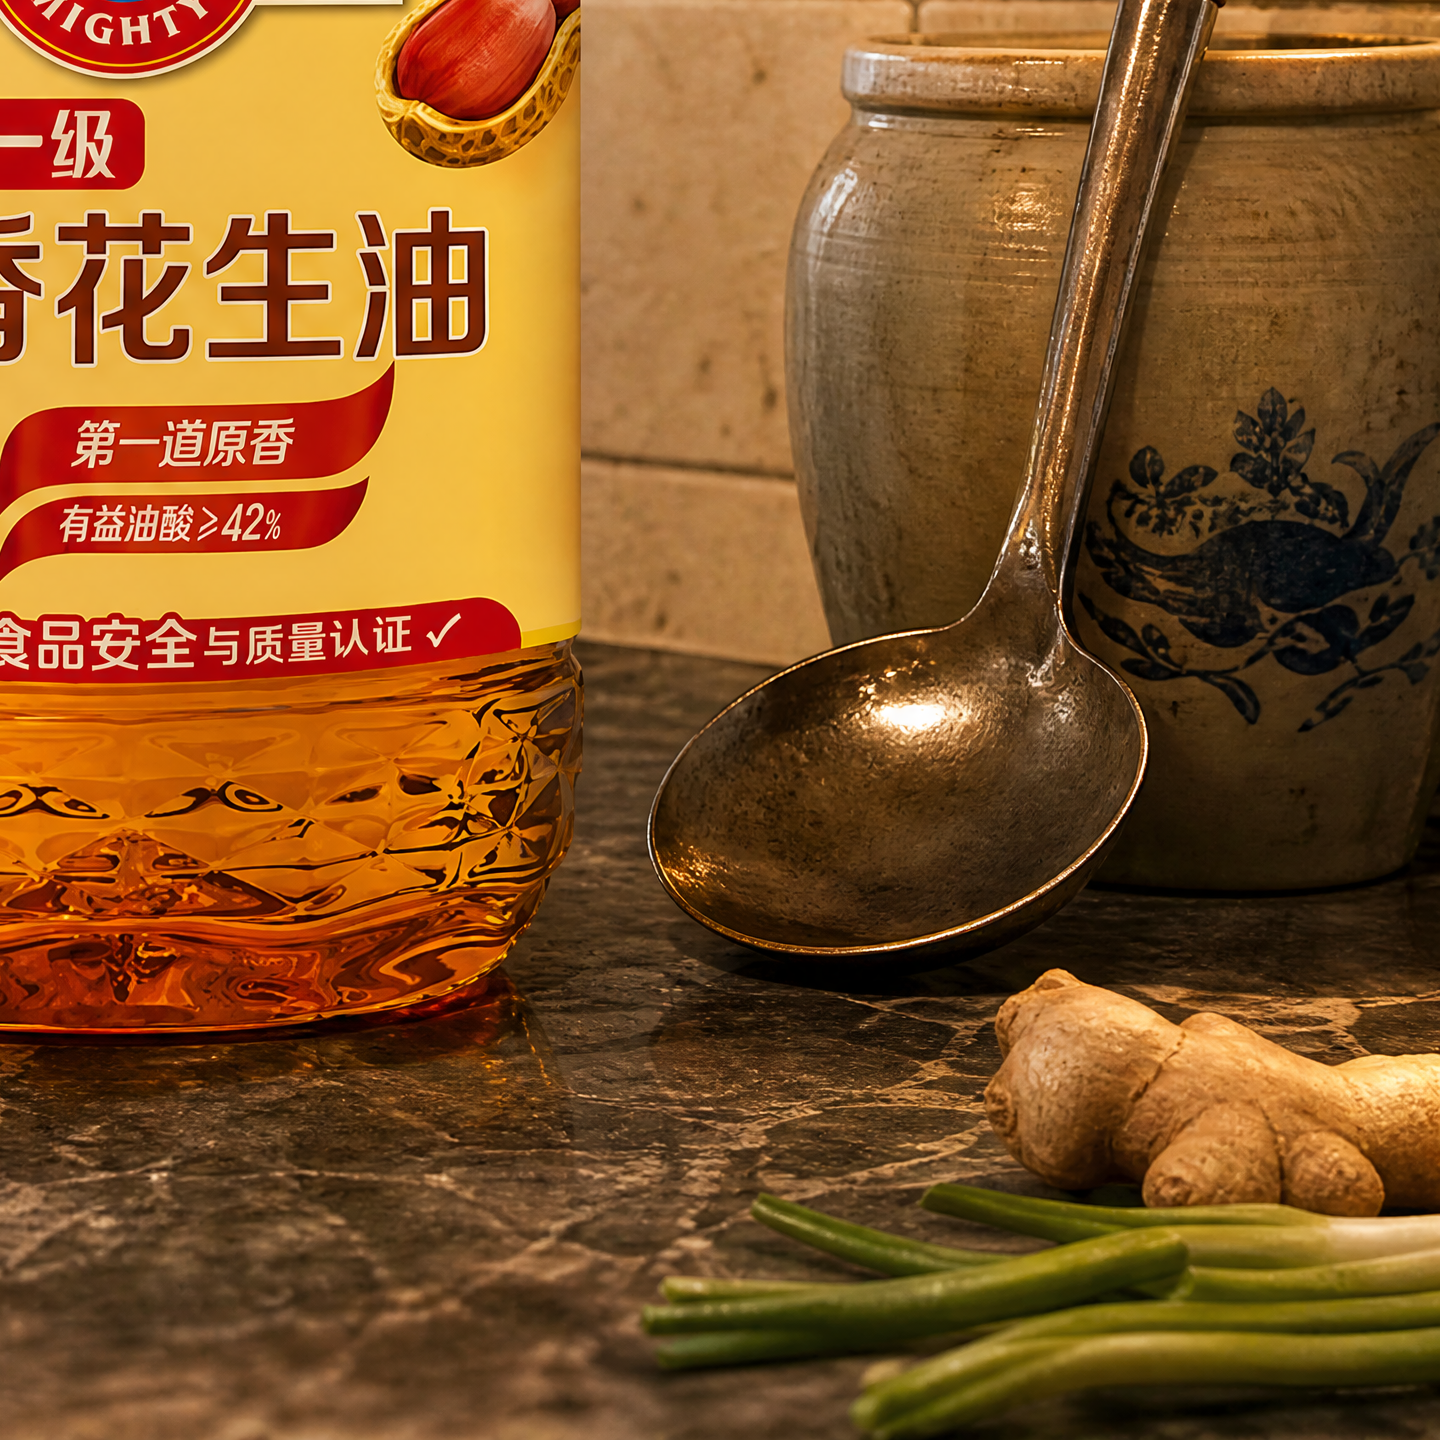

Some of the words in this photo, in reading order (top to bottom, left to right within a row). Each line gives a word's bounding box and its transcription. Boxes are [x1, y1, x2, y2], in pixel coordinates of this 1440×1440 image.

[71, 418, 295, 468] 第一道原香
